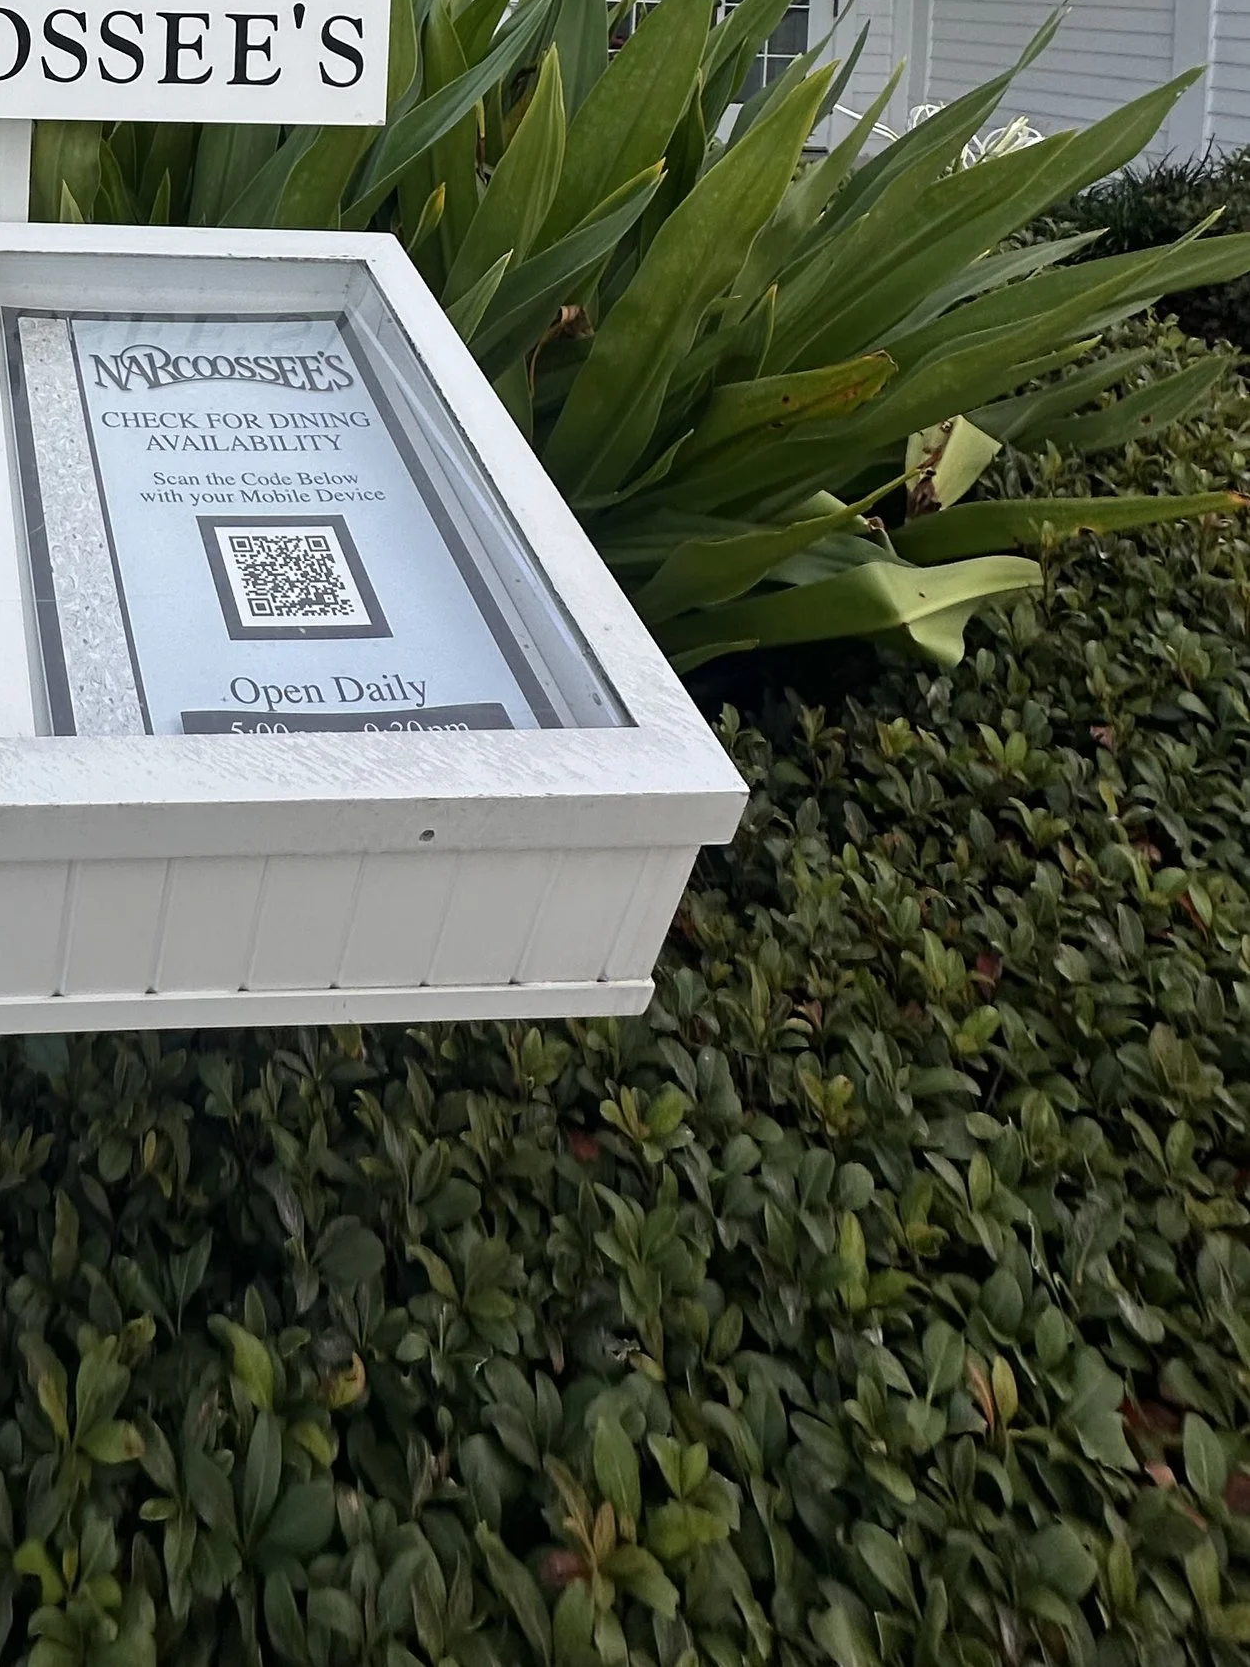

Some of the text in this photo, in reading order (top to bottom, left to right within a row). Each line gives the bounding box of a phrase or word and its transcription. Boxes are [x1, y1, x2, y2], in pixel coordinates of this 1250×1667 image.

[88, 343, 355, 392] NARCOOSSEE'S
[101, 410, 371, 430] CHECK FOR DINING
[145, 434, 343, 452] AVAILABILITY
[153, 471, 359, 486] Scan the Code Below
[140, 488, 387, 506] with your Mobile Device
[229, 673, 428, 712] Open Daily
